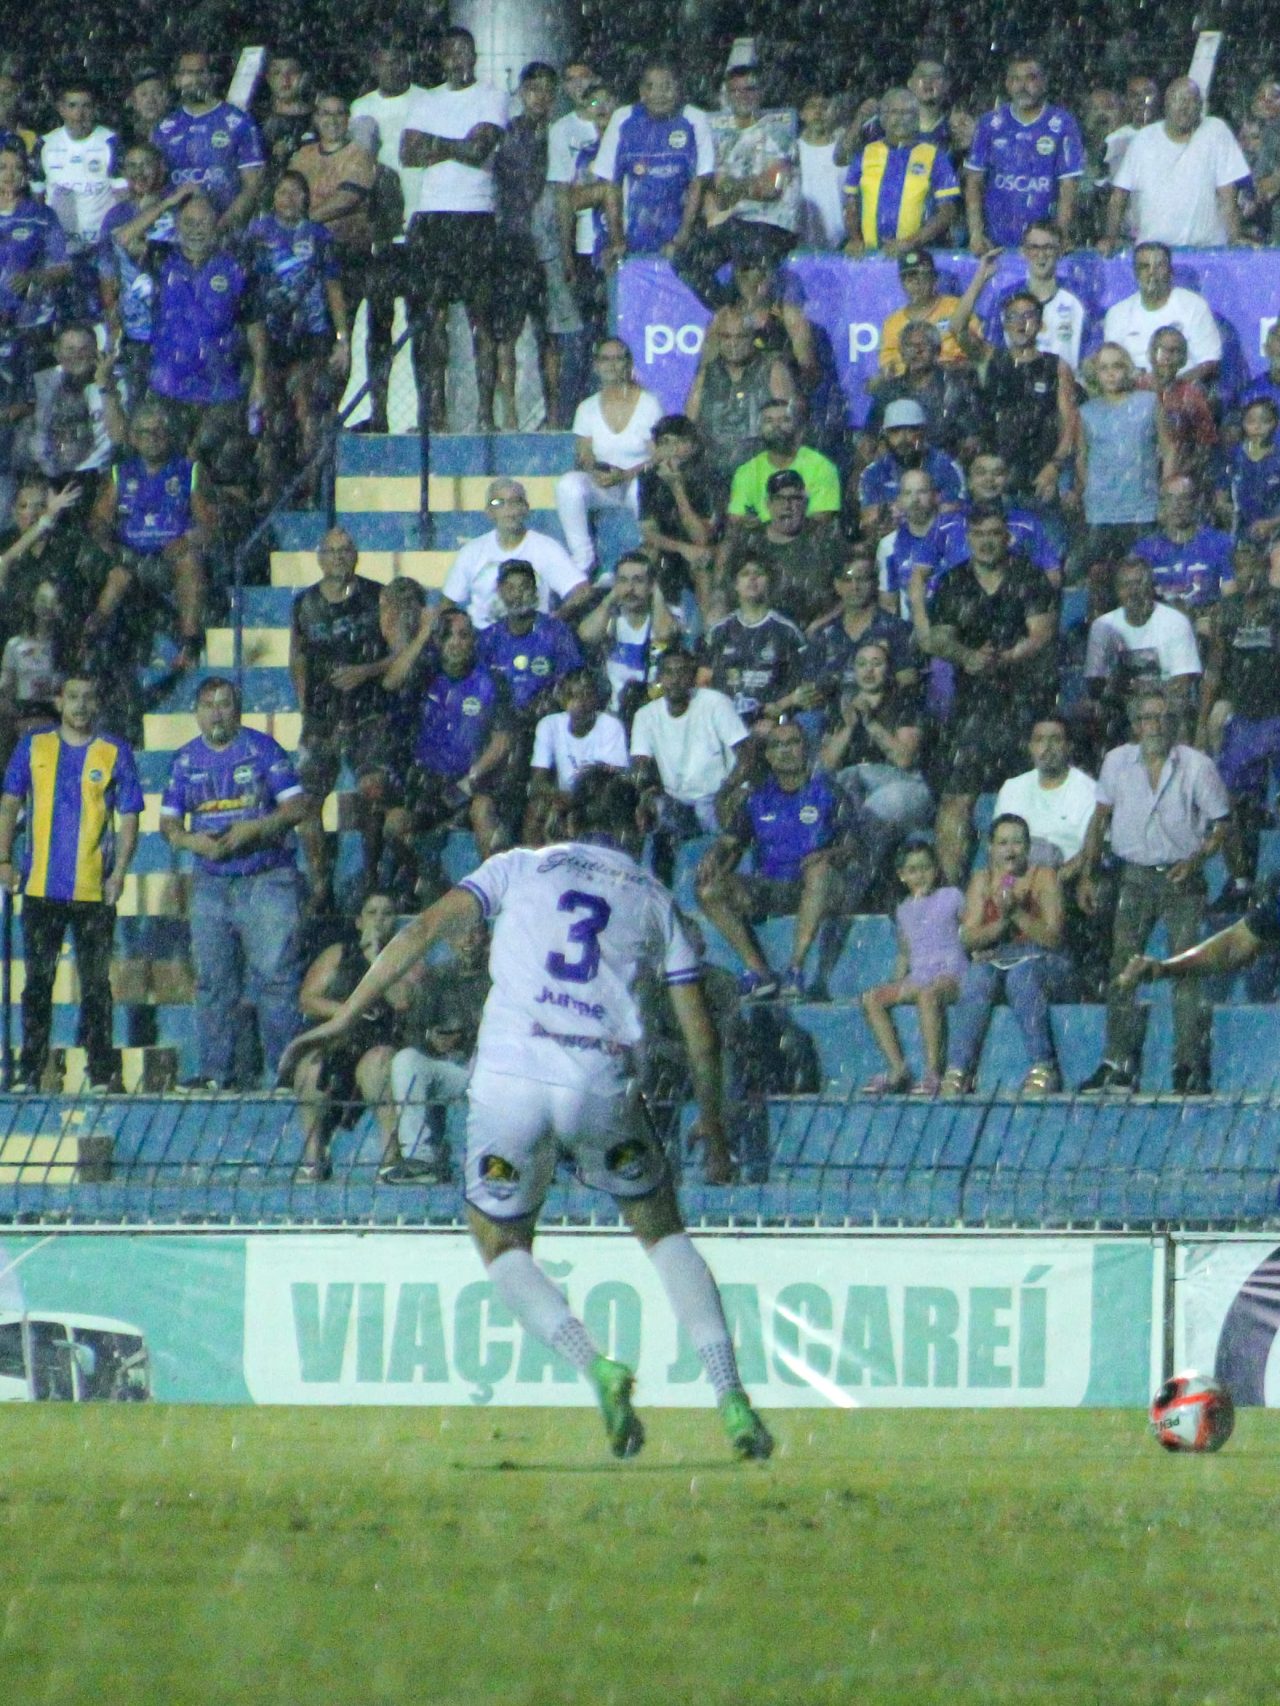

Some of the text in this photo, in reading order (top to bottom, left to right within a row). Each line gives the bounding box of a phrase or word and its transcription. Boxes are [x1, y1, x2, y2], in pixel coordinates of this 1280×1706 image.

[994, 174, 1050, 192] OSCAR
[545, 889, 611, 984] 3
[291, 1260, 1053, 1404] VIAÇÃO JACAREÍ
